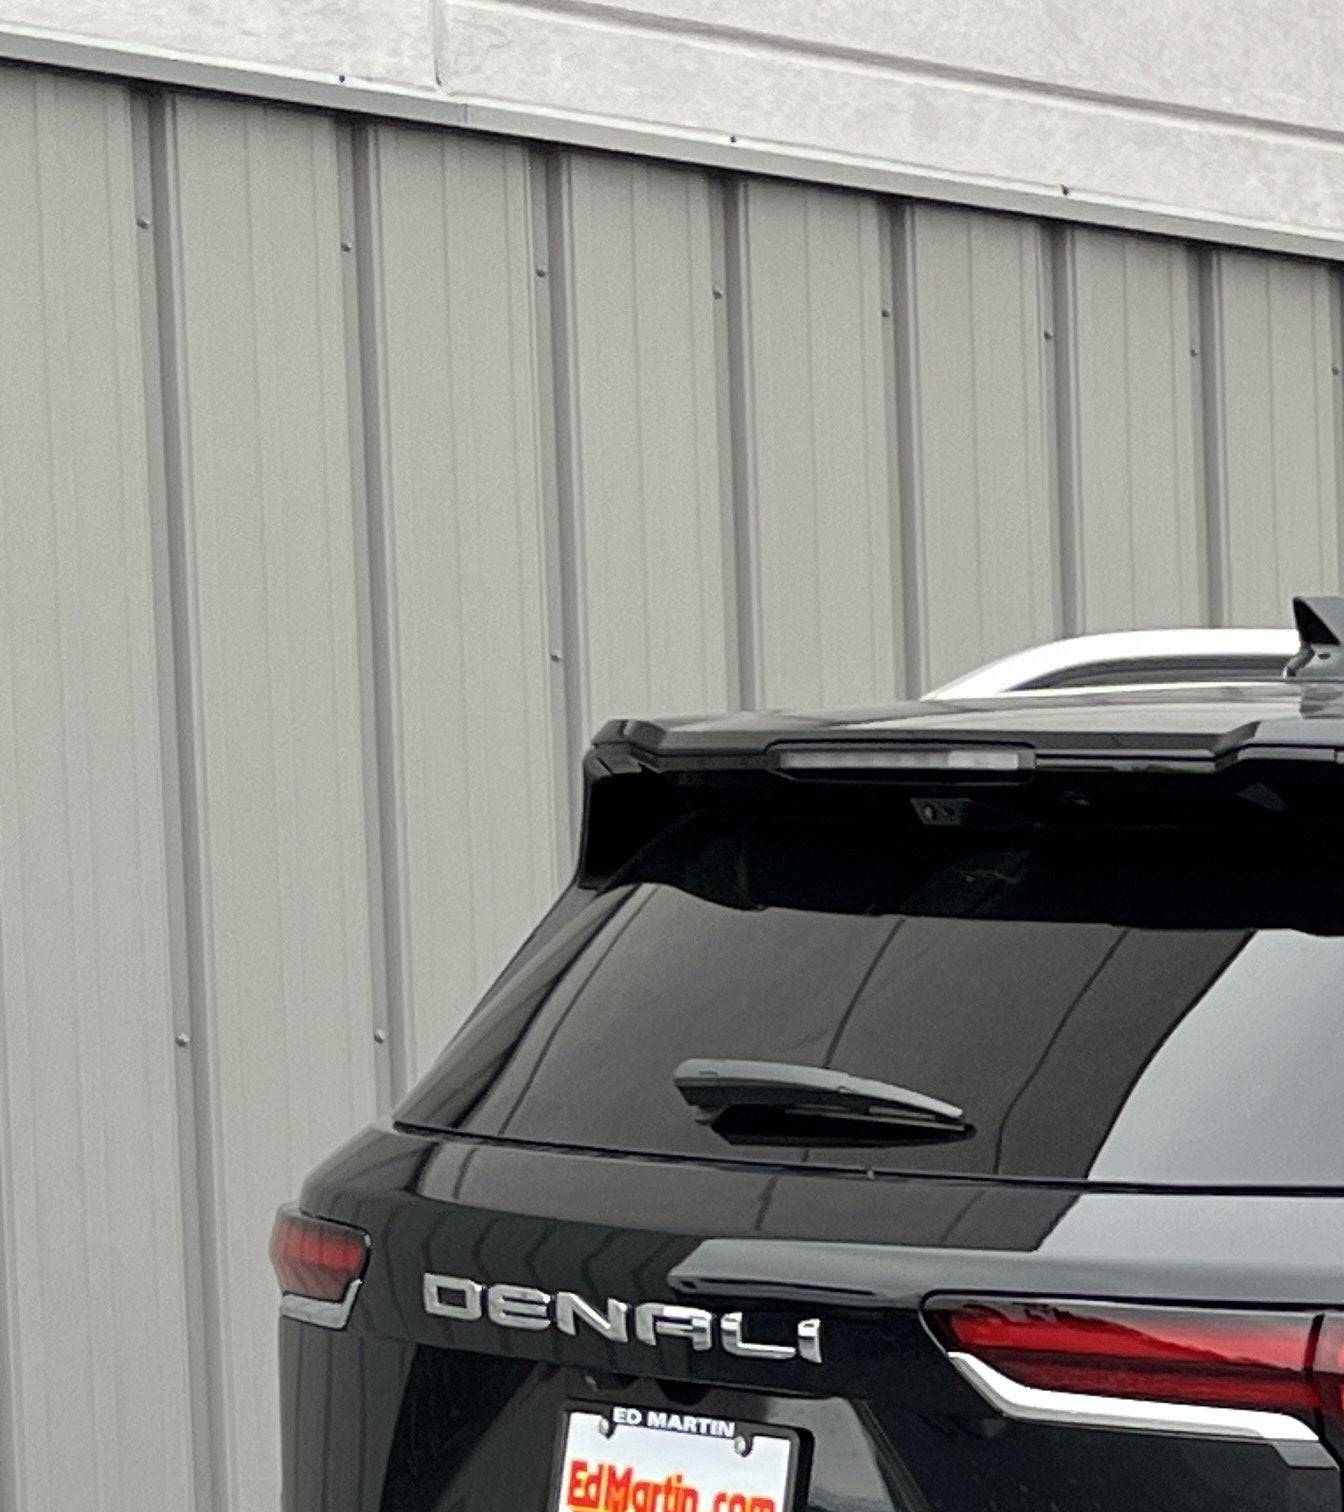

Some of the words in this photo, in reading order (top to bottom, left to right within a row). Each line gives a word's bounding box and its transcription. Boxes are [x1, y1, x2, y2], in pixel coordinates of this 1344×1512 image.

[424, 1272, 822, 1363] DENALI
[613, 1407, 642, 1427] ED
[647, 1410, 736, 1438] MARTIN
